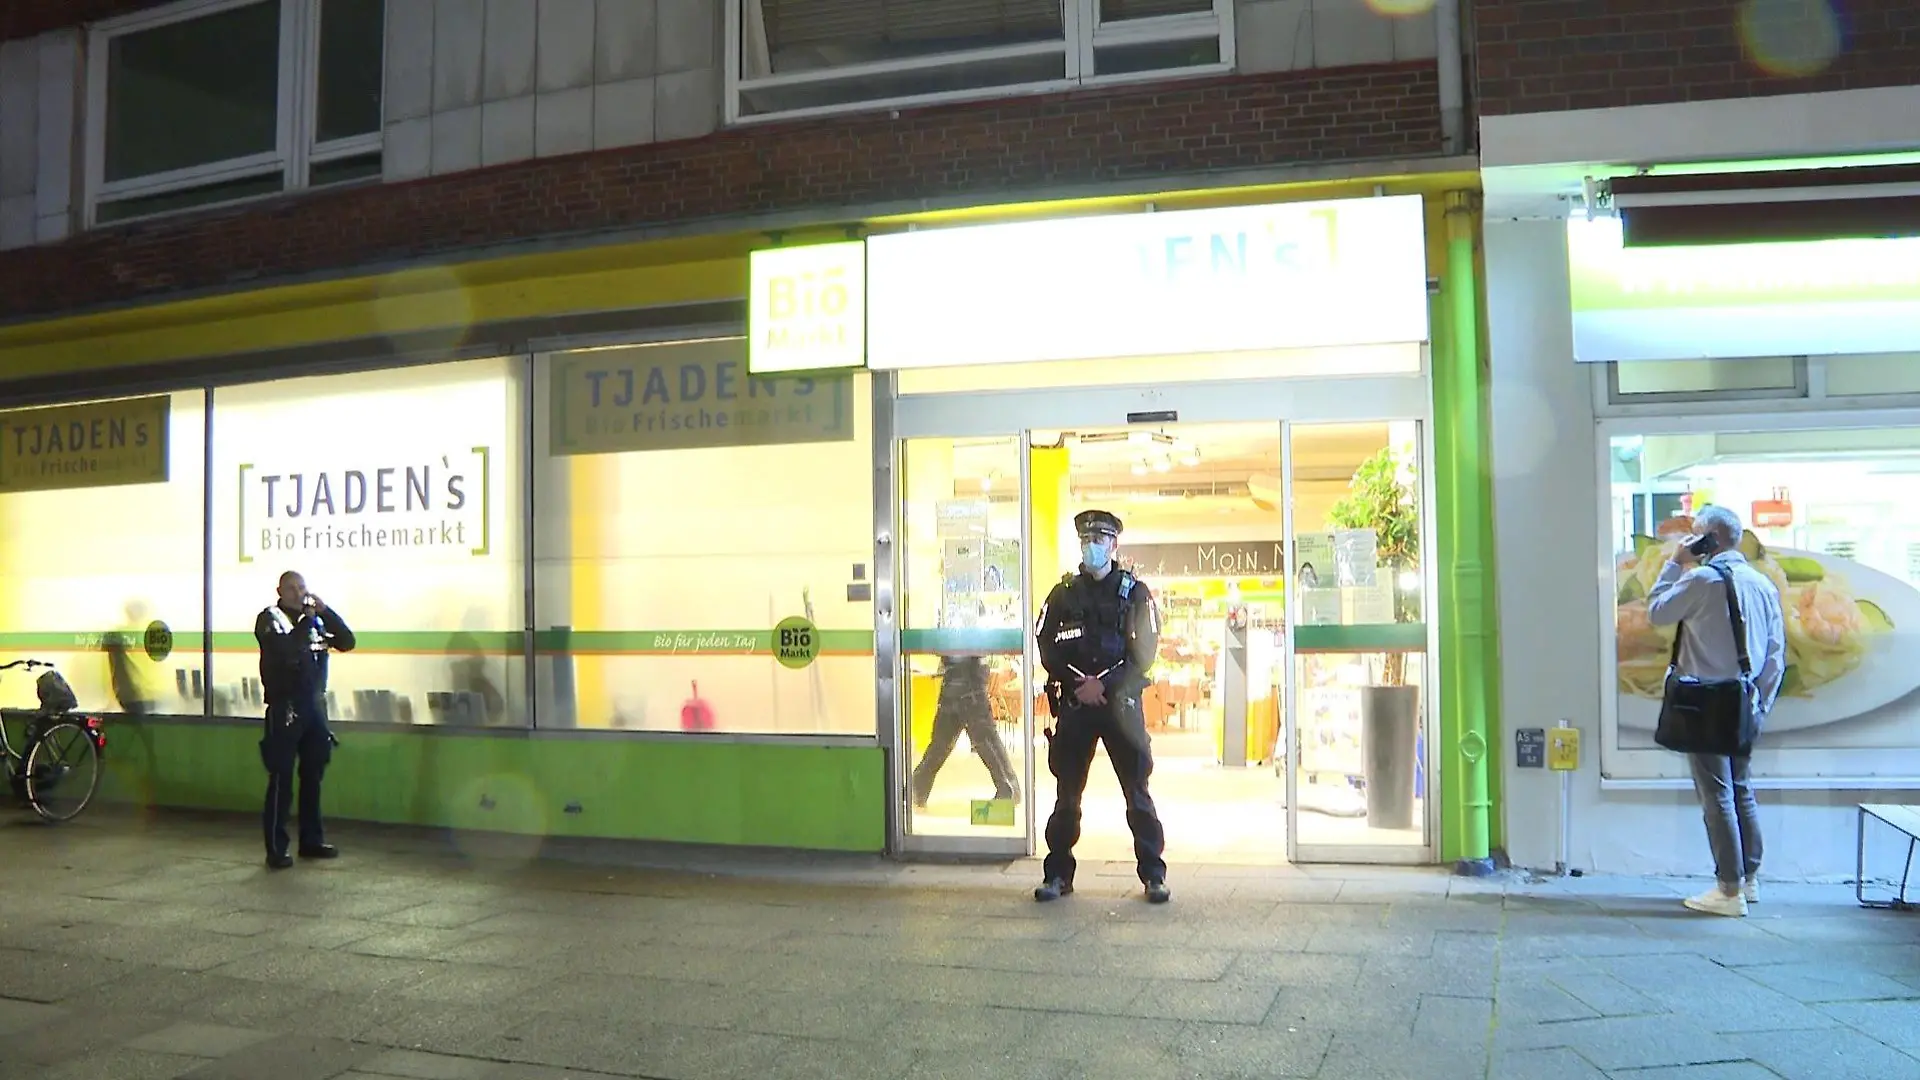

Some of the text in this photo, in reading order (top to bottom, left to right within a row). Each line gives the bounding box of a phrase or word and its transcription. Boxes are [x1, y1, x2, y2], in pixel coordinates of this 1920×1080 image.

[303, 520, 466, 549] Frischemarkt
[654, 632, 757, 655] Bio für jeden Tag
[780, 649, 811, 658] Markt
